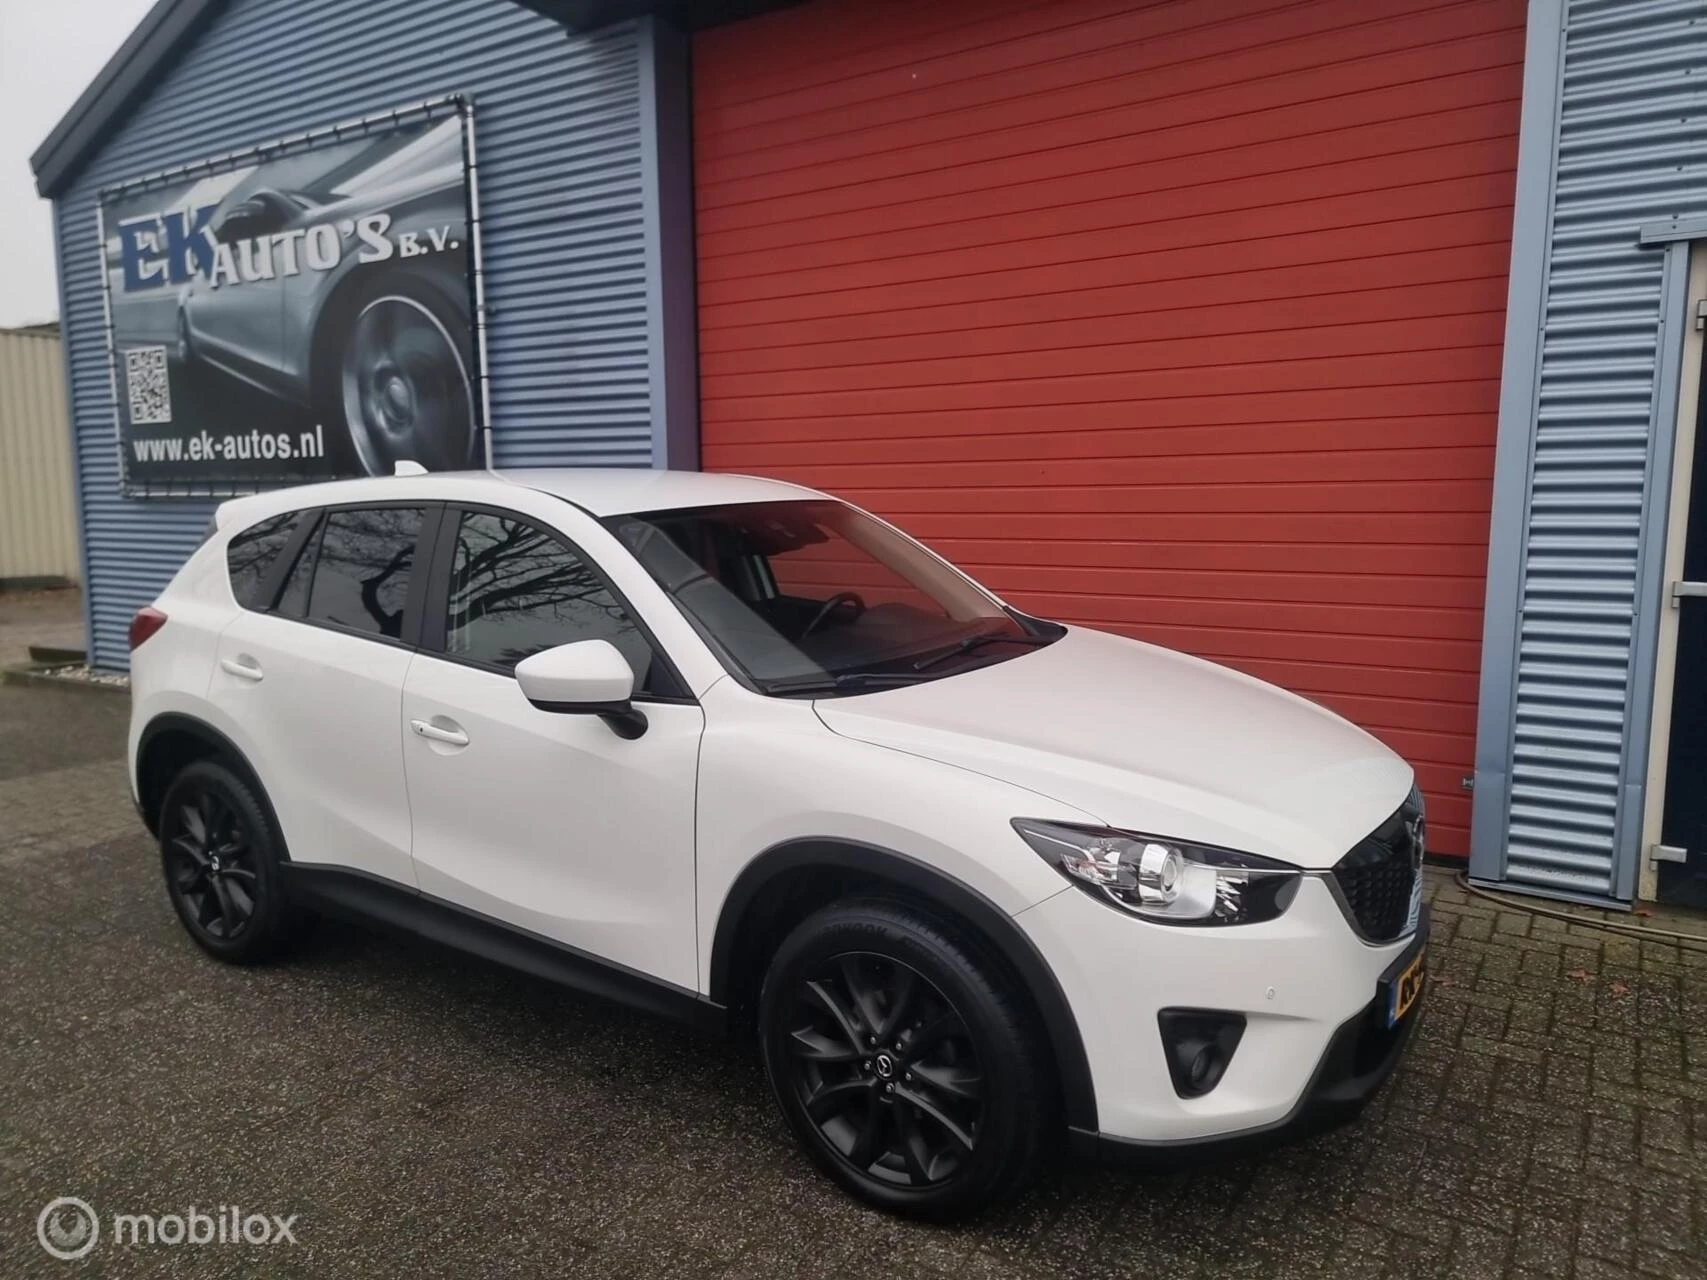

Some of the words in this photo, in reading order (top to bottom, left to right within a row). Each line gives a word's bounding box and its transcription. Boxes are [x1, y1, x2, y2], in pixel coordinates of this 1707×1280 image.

[118, 204, 219, 291] EK
[210, 213, 394, 289] AUTO'S
[400, 225, 459, 258] B.V.
[133, 425, 324, 463] www.ek-autos.nl
